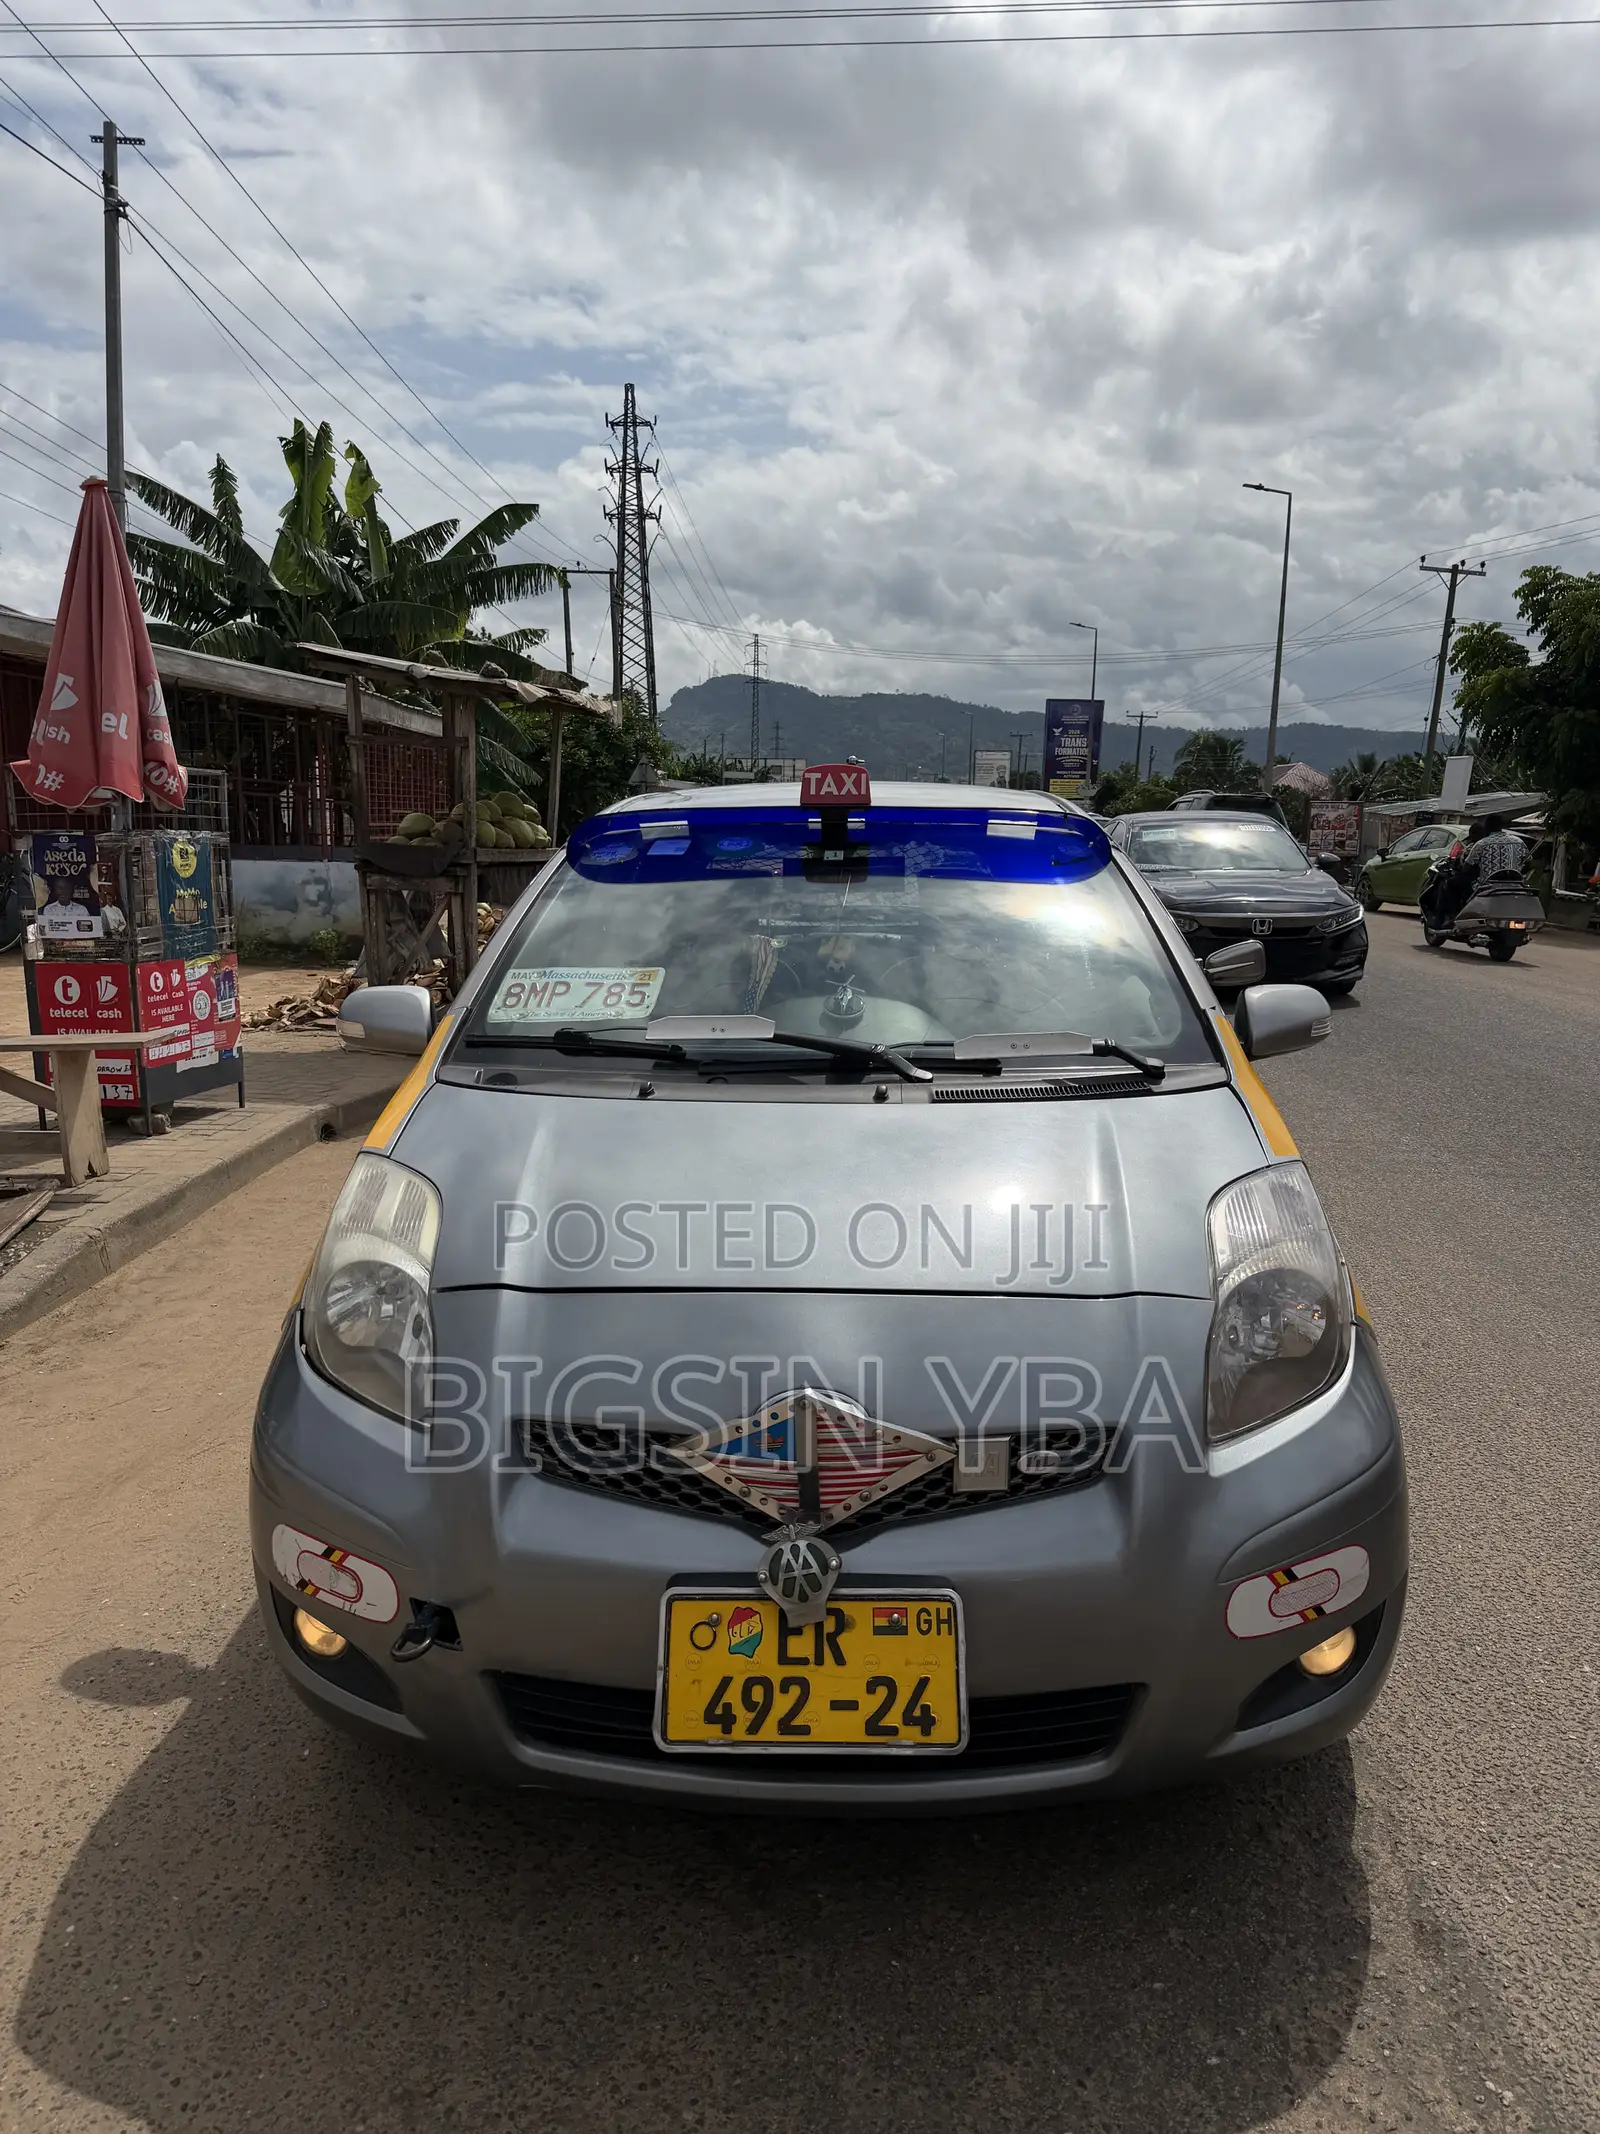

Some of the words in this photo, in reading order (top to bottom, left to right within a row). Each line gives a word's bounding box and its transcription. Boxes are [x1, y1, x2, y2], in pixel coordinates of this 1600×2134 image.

[1055, 747, 1090, 756] FORMATIO
[805, 771, 868, 796] TAXI
[511, 972, 534, 980] MAY
[639, 973, 653, 981] 21
[147, 992, 169, 1003] telecel
[503, 981, 573, 1009] 8MP
[579, 982, 651, 1008] 785
[49, 1007, 89, 1019] telecel
[96, 1007, 122, 1019] cash
[157, 1004, 184, 1016] AVAILABLE
[161, 1014, 175, 1023] HERE
[777, 1607, 847, 1667] ER
[916, 1607, 953, 1637] GH
